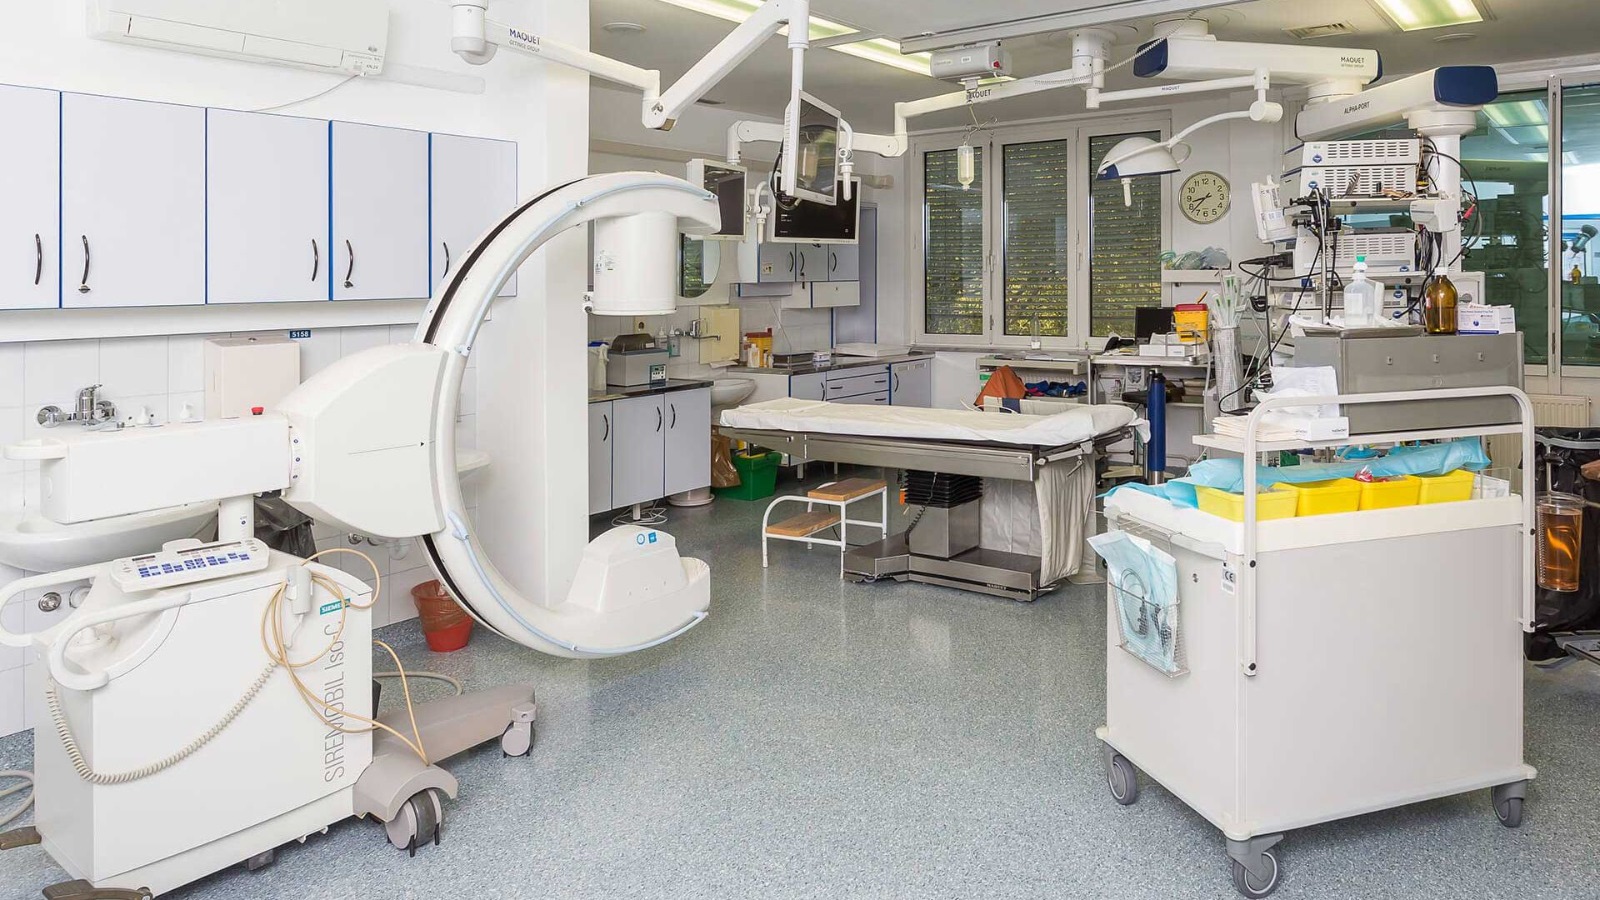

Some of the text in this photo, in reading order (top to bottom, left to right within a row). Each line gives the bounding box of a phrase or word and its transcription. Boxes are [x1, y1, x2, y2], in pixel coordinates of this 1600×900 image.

[509, 28, 540, 45] MAQUET
[1344, 101, 1370, 114] ALPHA-PORT
[1193, 179, 1200, 187] 11
[1187, 186, 1196, 194] 10
[1219, 193, 1225, 201] 3
[1202, 210, 1209, 218] 6
[1211, 208, 1218, 216] 5
[324, 671, 345, 783] SIREMOBIL
